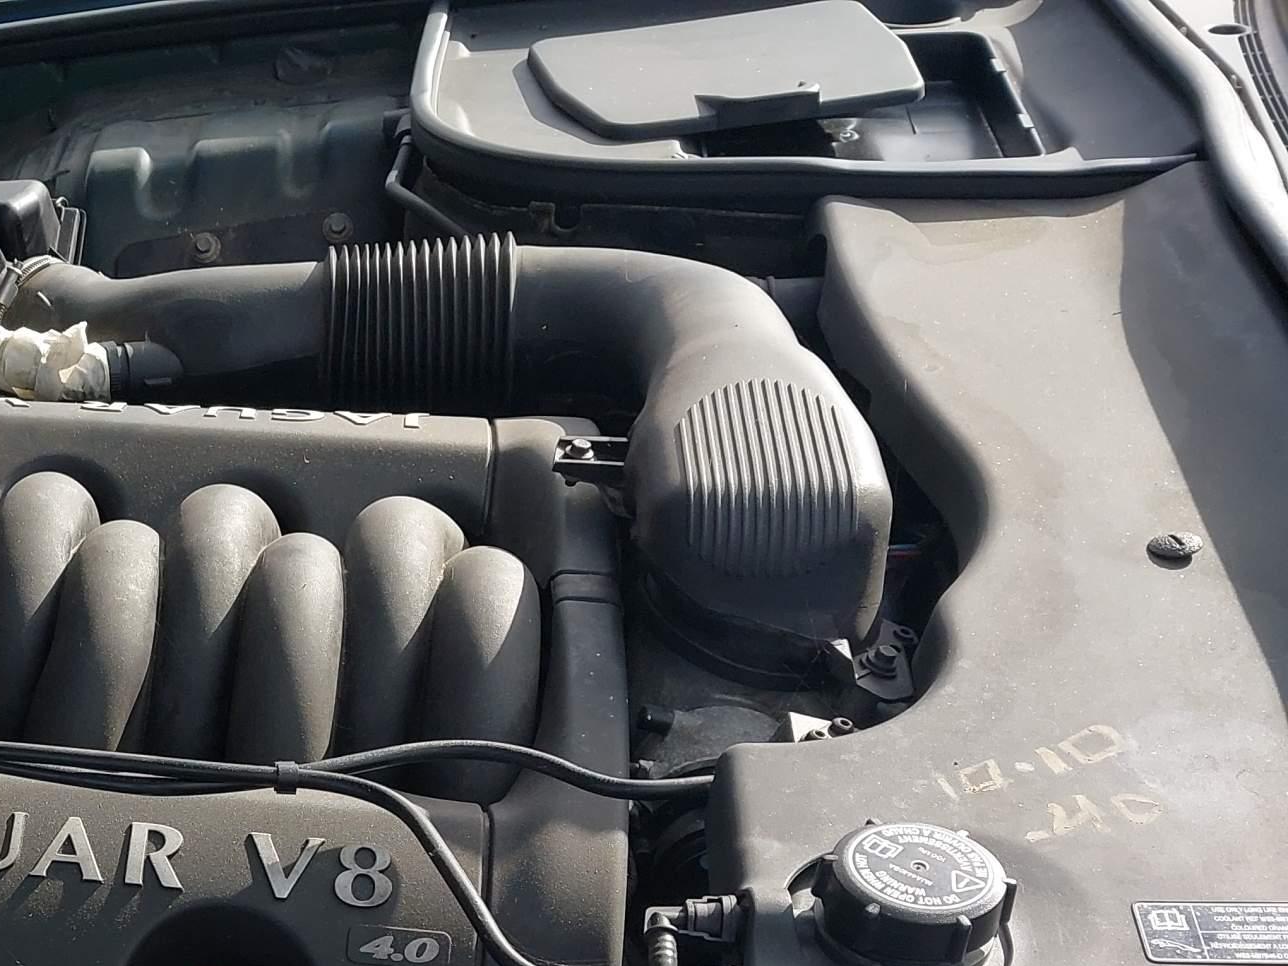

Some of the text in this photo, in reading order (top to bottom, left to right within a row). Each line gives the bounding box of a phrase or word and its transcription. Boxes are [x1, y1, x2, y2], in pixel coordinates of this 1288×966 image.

[897, 834, 972, 872] AVERTISSEMENT
[248, 831, 394, 908] V8
[862, 868, 883, 892] WHEN
[873, 870, 926, 896] WARNING
[884, 886, 915, 903] OPEN
[916, 895, 942, 905] NOT
[943, 894, 960, 904] DO
[359, 935, 441, 965] 4.0
